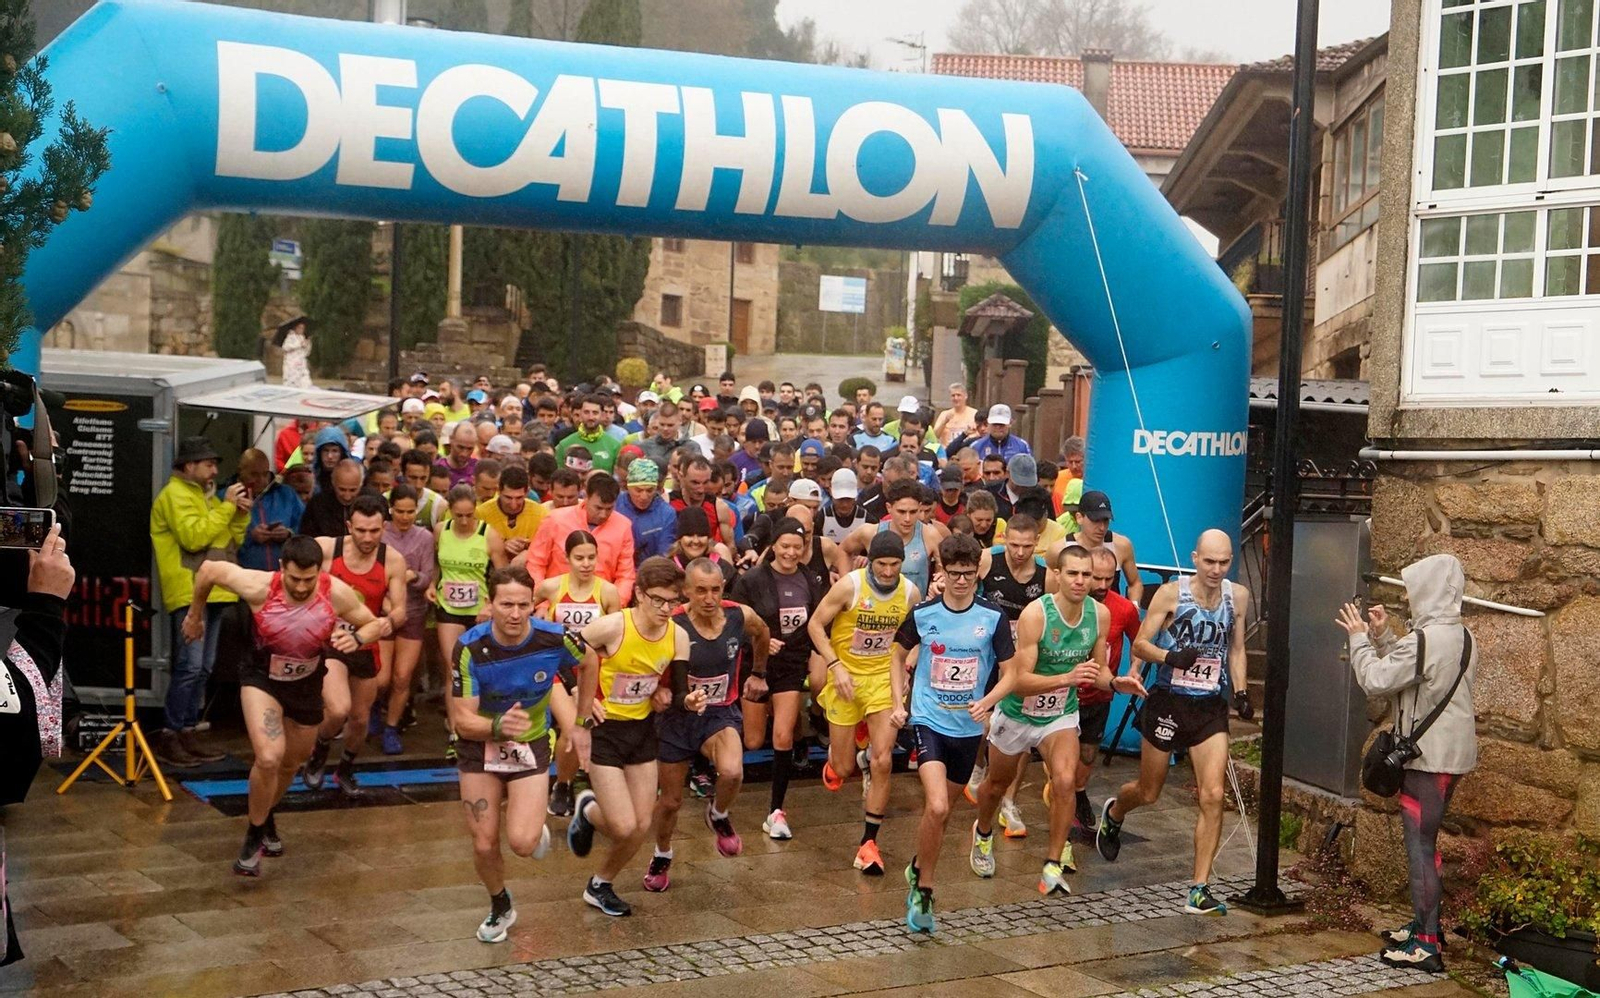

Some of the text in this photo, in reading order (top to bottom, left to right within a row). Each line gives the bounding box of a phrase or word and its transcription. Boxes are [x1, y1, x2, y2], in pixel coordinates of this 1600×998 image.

[215, 40, 1036, 229] DECATHLON
[1133, 429, 1248, 456] DECATHLON
[449, 587, 473, 600] 251
[563, 610, 593, 625] 202
[782, 614, 801, 627] 36
[857, 613, 900, 625] ATHLETICS
[1176, 619, 1228, 645] ADN
[864, 637, 883, 649] 92
[284, 663, 306, 675] 56
[950, 666, 961, 681] 2
[631, 681, 641, 695] 4
[938, 693, 974, 702] RODOSA
[1036, 695, 1057, 709] 39
[1155, 726, 1176, 737] ADN
[500, 746, 519, 762] 54
